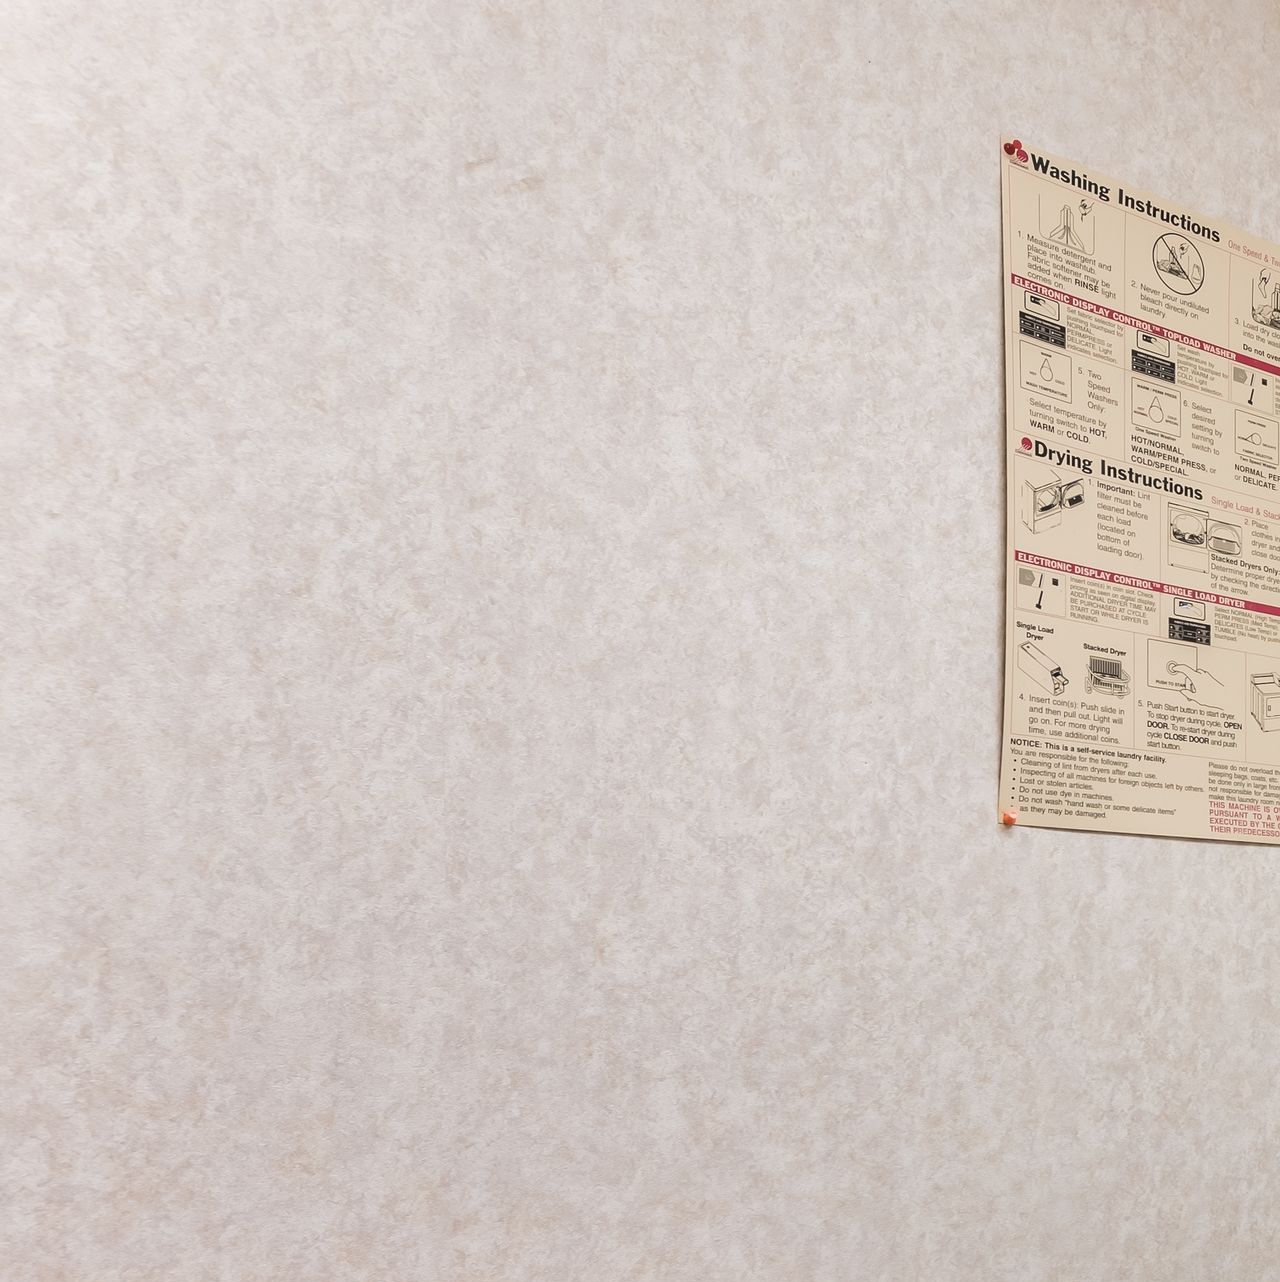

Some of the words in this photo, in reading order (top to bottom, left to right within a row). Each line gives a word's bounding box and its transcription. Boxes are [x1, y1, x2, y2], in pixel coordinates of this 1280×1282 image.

[1030, 153, 1110, 201] Washing
[1118, 188, 1219, 242] Instructions
[1228, 239, 1240, 251] One
[1242, 245, 1262, 260] Speed
[1014, 276, 1069, 303] ELECTRONIC
[1072, 298, 1109, 316] DISPLAY
[1162, 329, 1200, 347] TOPLOAD
[1202, 343, 1236, 360] WASHER
[1242, 343, 1252, 352] Do
[1254, 348, 1264, 356] not
[1029, 419, 1054, 433] WARM
[1034, 440, 1092, 474] Drying
[1101, 459, 1202, 500] Instructions
[1097, 480, 1135, 496] Important:
[1137, 491, 1150, 500] Lint
[1211, 496, 1233, 509] Single
[1235, 502, 1253, 513] Load
[1210, 553, 1238, 565] Stacked
[1239, 560, 1261, 570] Dryers
[1263, 565, 1280, 576] Only:
[1018, 553, 1071, 571] ELECTRONIC
[1074, 565, 1110, 580] DISPLAY
[1163, 585, 1192, 597] SINGLE
[1195, 591, 1216, 602] LOAD
[1219, 596, 1245, 608] DRYER
[1016, 620, 1036, 630] Single
[1037, 625, 1053, 634] Load
[1026, 631, 1043, 640] Dryer
[1083, 643, 1108, 653] Stacked
[1109, 647, 1126, 656] Dryer
[1010, 738, 1042, 748] NOTICE:
[1044, 742, 1060, 750] This
[1076, 747, 1115, 756] self-service
[1117, 751, 1142, 761] laundry
[1143, 754, 1167, 764] facility.
[1209, 800, 1225, 808] THIS
[1228, 802, 1260, 812] MACHINE
